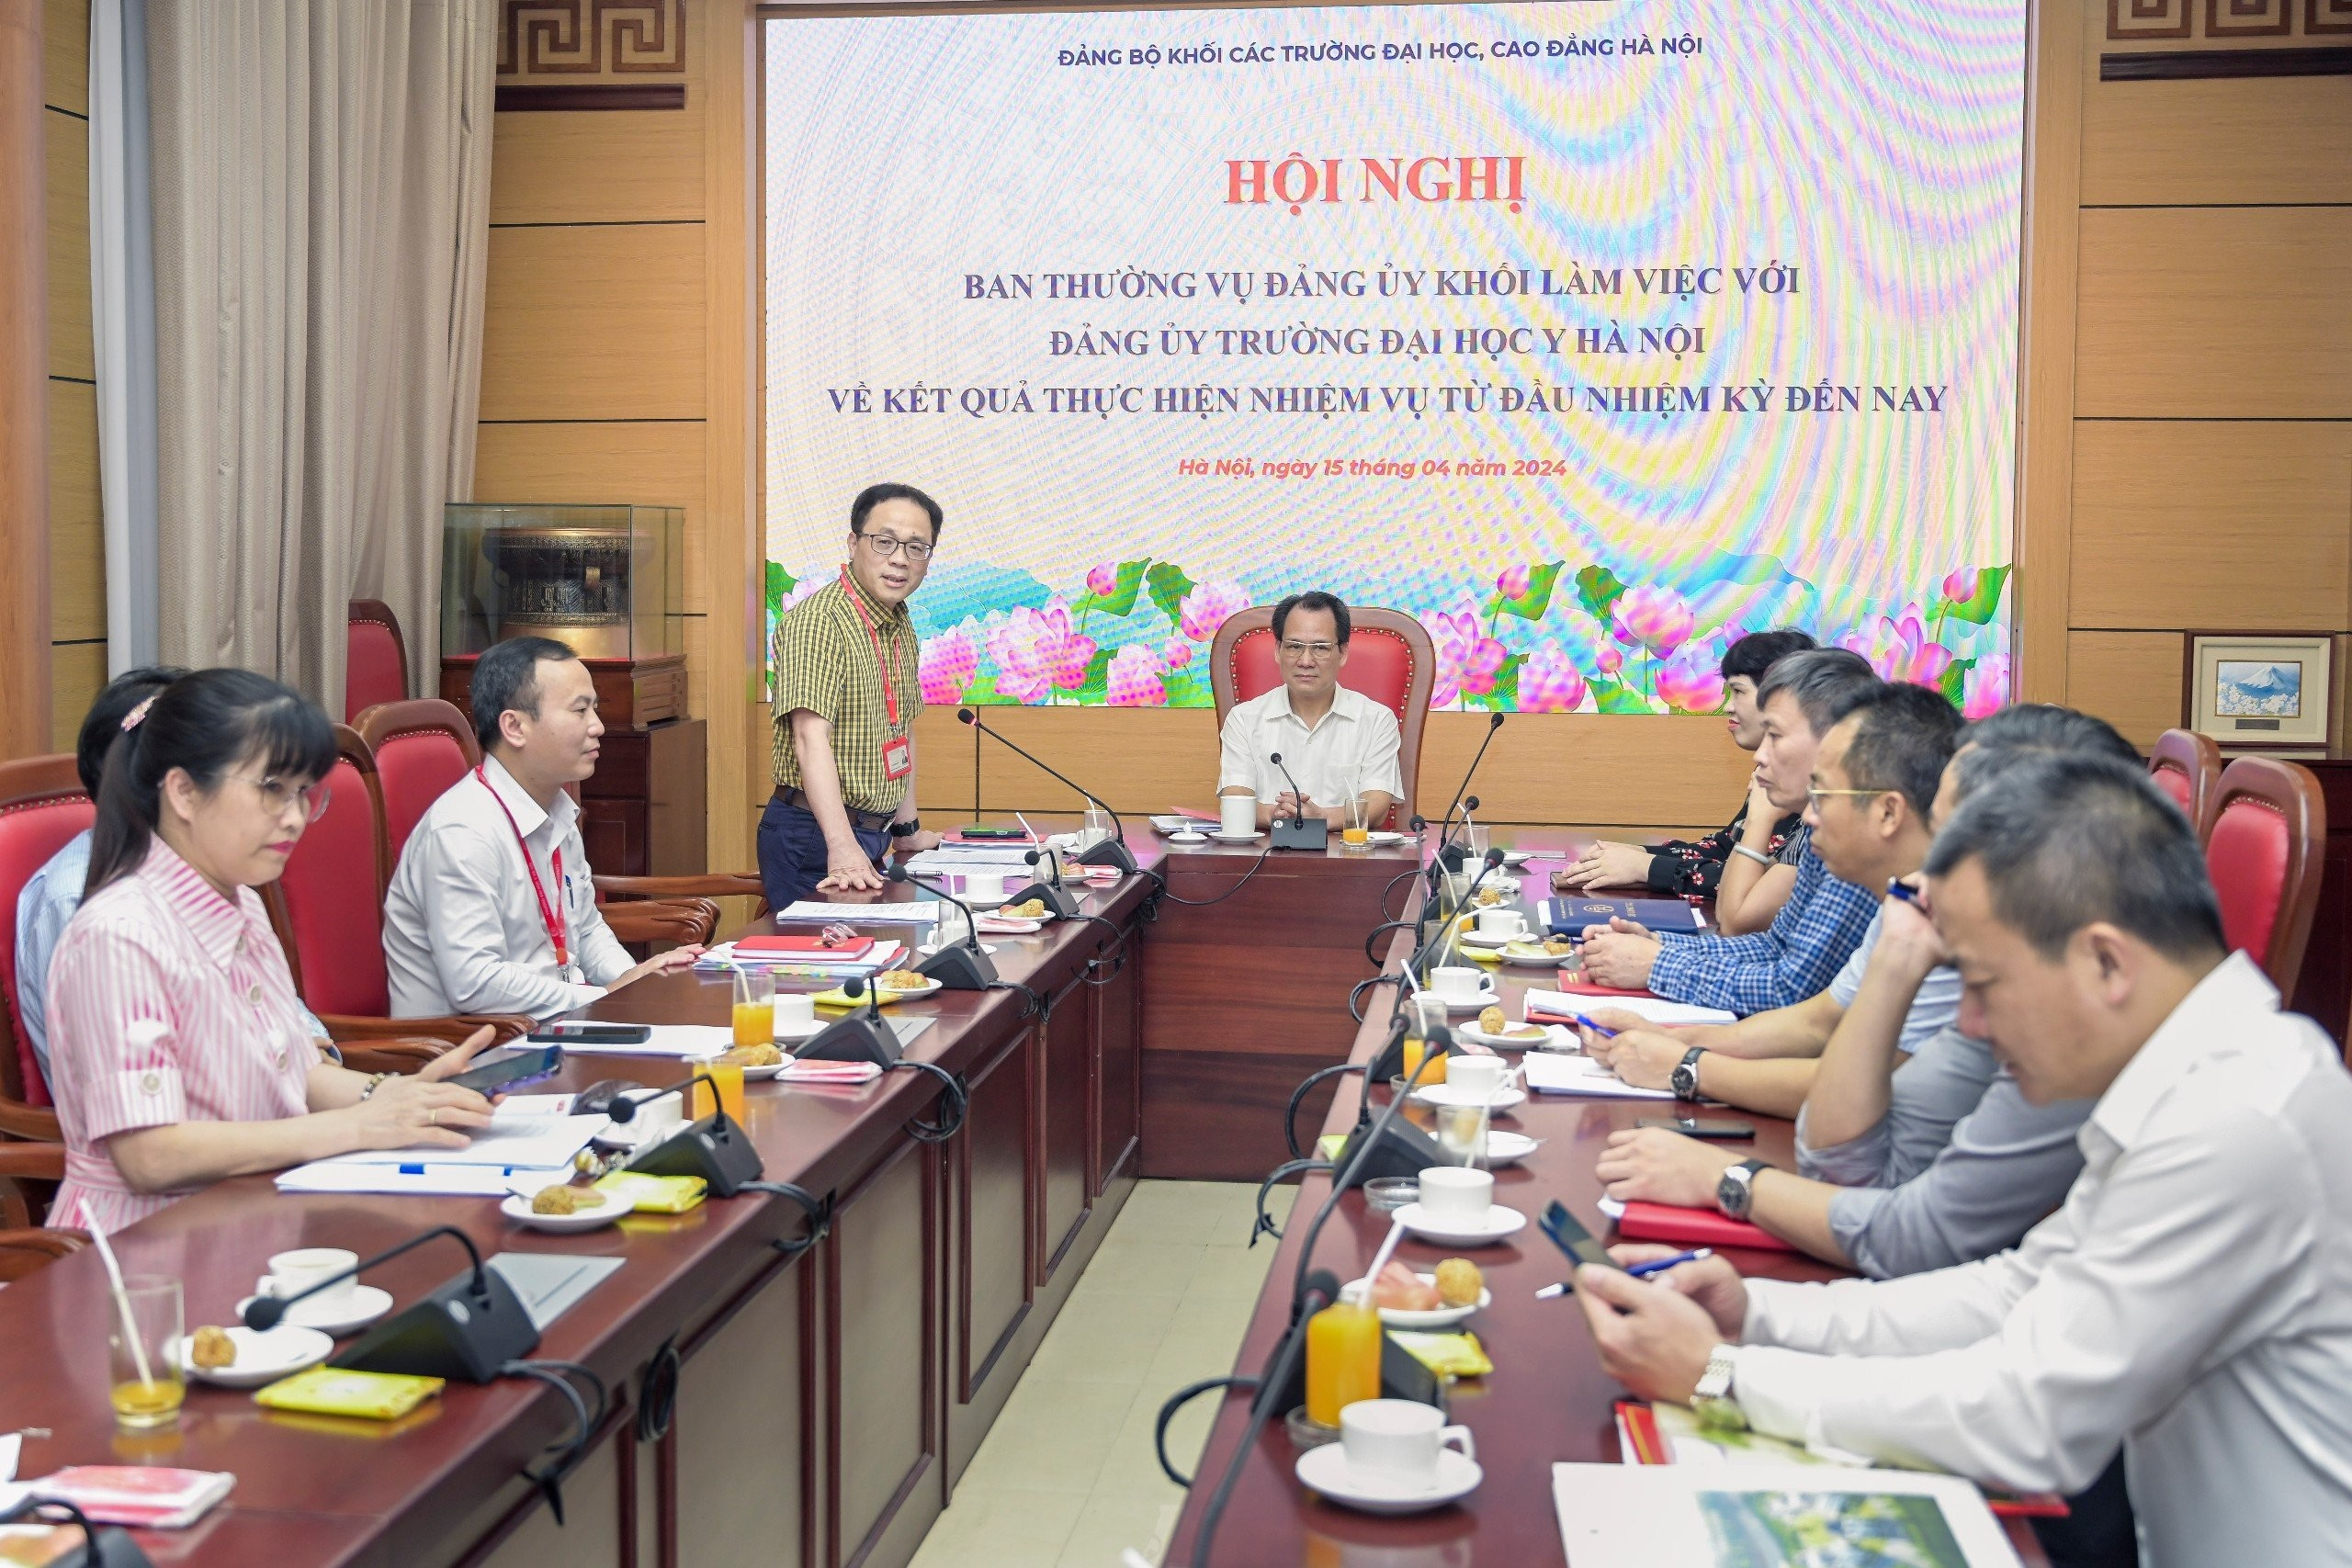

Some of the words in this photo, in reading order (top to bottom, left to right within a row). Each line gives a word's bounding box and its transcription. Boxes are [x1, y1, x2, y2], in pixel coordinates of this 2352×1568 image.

[1057, 42, 1122, 66] ĐẢNG
[1130, 42, 1161, 69] BỘ
[1168, 39, 1222, 64] KHỐI
[1229, 40, 1274, 64] CÁC
[1281, 39, 1374, 62] TRƯỜNG
[1382, 42, 1422, 64] ĐẠI
[1430, 41, 1485, 64] HỌC,
[1491, 39, 1540, 58] CAO
[1546, 31, 1613, 57] ĐẲNG
[1622, 34, 1656, 56] HÀ
[1662, 33, 1702, 59] NỘI
[1224, 152, 1342, 215] HỘI
[1360, 156, 1526, 214] NGHỊ
[964, 274, 1034, 299] BAN
[1044, 265, 1196, 299] THƯỜNG
[1205, 273, 1253, 305] VỤ
[1264, 263, 1366, 298] ĐẢNG
[1378, 261, 1427, 297] ỦY
[1435, 262, 1531, 296] KHỐI
[1541, 261, 1624, 296] LÀM
[1634, 263, 1723, 302] VIỆC
[1733, 259, 1800, 295] VỚI
[1049, 322, 1149, 355] ĐẢNG
[1160, 321, 1208, 355] ỦY
[1216, 321, 1370, 355] TRƯỜNG
[1379, 328, 1442, 362] ĐẠI
[1453, 328, 1532, 362] HỌC
[1541, 328, 1567, 354] Y
[1577, 319, 1629, 354] HÀ
[1638, 322, 1706, 361] NỘI
[828, 380, 872, 413] VỀ
[883, 379, 952, 413] KẾT
[960, 379, 1035, 419] QUẢ
[1044, 383, 1143, 421] THỰC
[1153, 383, 1238, 421] HIỆN
[1250, 382, 1371, 421] NHIỆM
[1380, 387, 1430, 421] VỤ
[1439, 378, 1492, 413] TỪ
[1499, 378, 1575, 413] ĐẦU
[1586, 382, 1712, 420] NHIỆM
[1721, 378, 1776, 412] KỲ
[1784, 378, 1861, 412] ĐẾN
[1871, 385, 1949, 412] NAY
[1179, 458, 1209, 476] Hà
[1216, 457, 1255, 480] Nội,
[1261, 461, 1317, 480] ngày
[1325, 458, 1343, 476] 15
[1350, 460, 1416, 480] tháng
[1421, 460, 1450, 477] 04
[1455, 458, 1506, 476] năm
[1513, 459, 1567, 477] 2024
